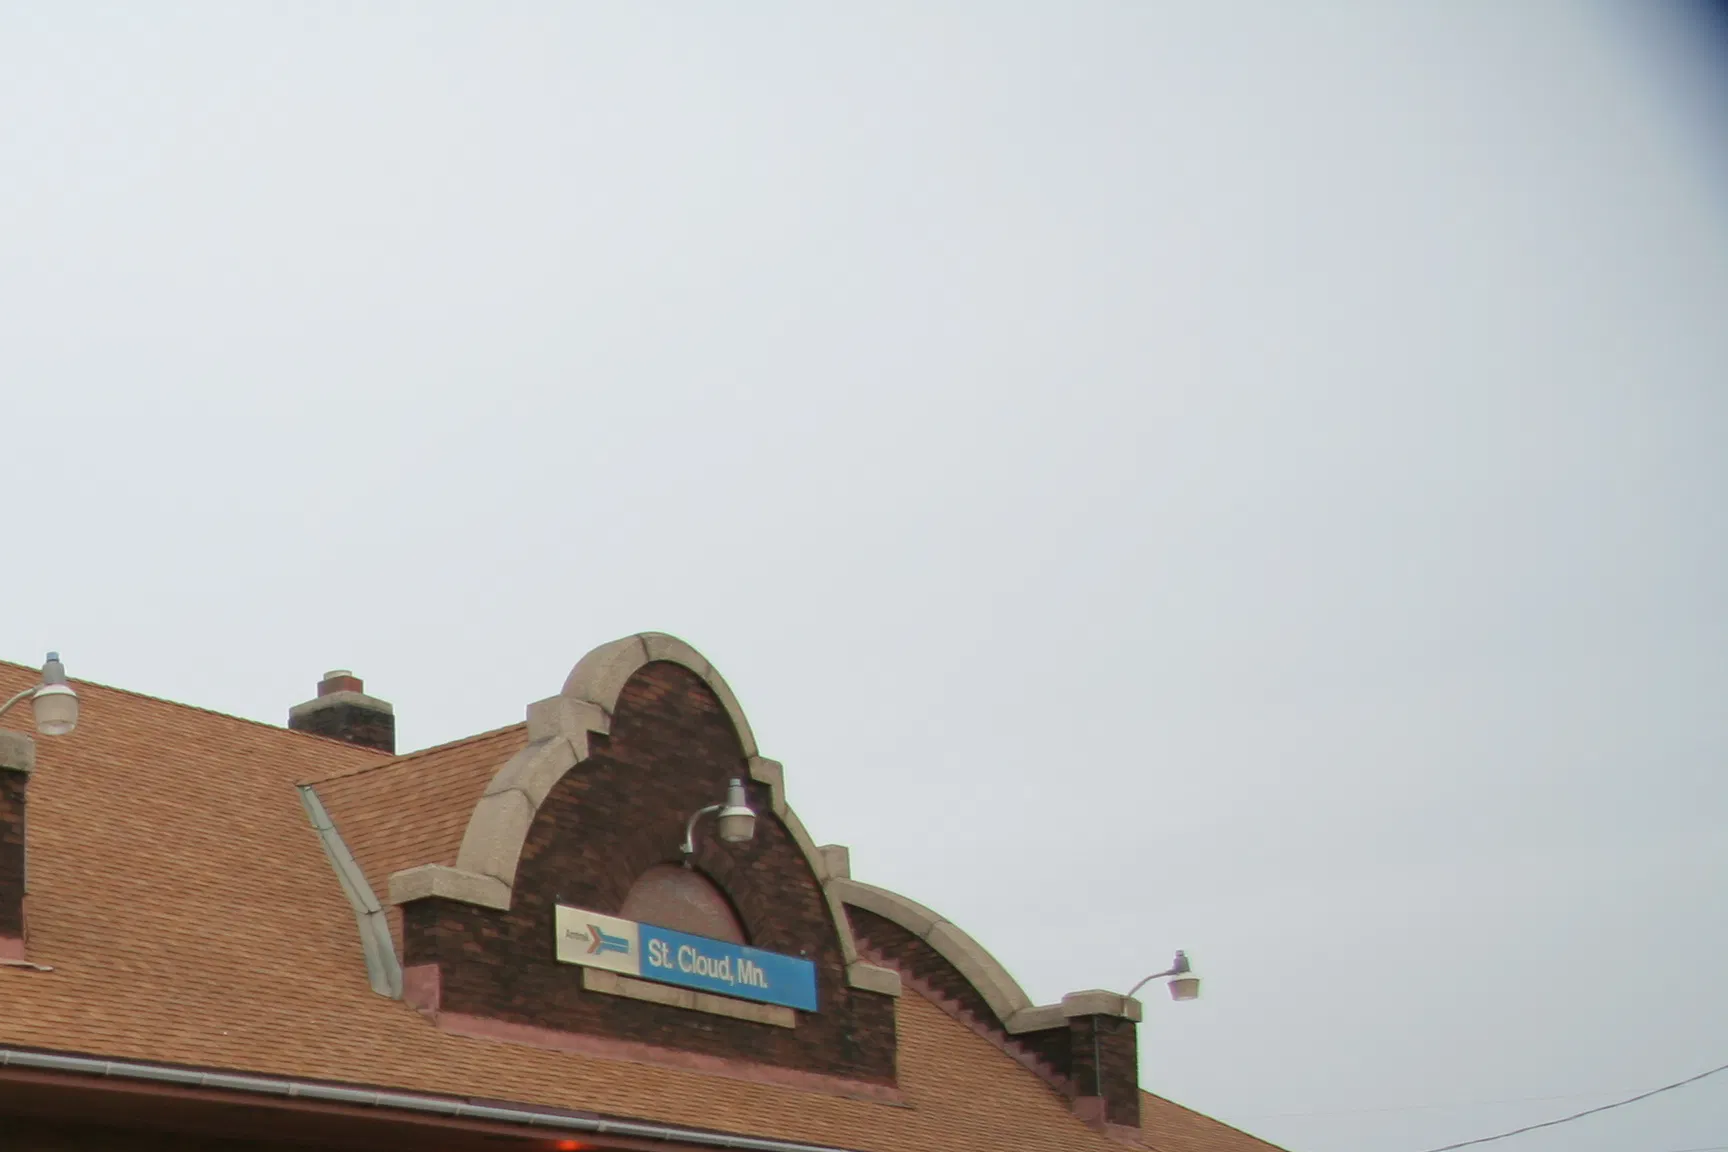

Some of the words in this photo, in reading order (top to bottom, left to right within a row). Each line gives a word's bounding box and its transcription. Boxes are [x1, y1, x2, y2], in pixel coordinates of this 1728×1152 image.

[647, 938, 673, 969] St.
[677, 944, 735, 987] Cloud,
[736, 957, 769, 989] Mn.
